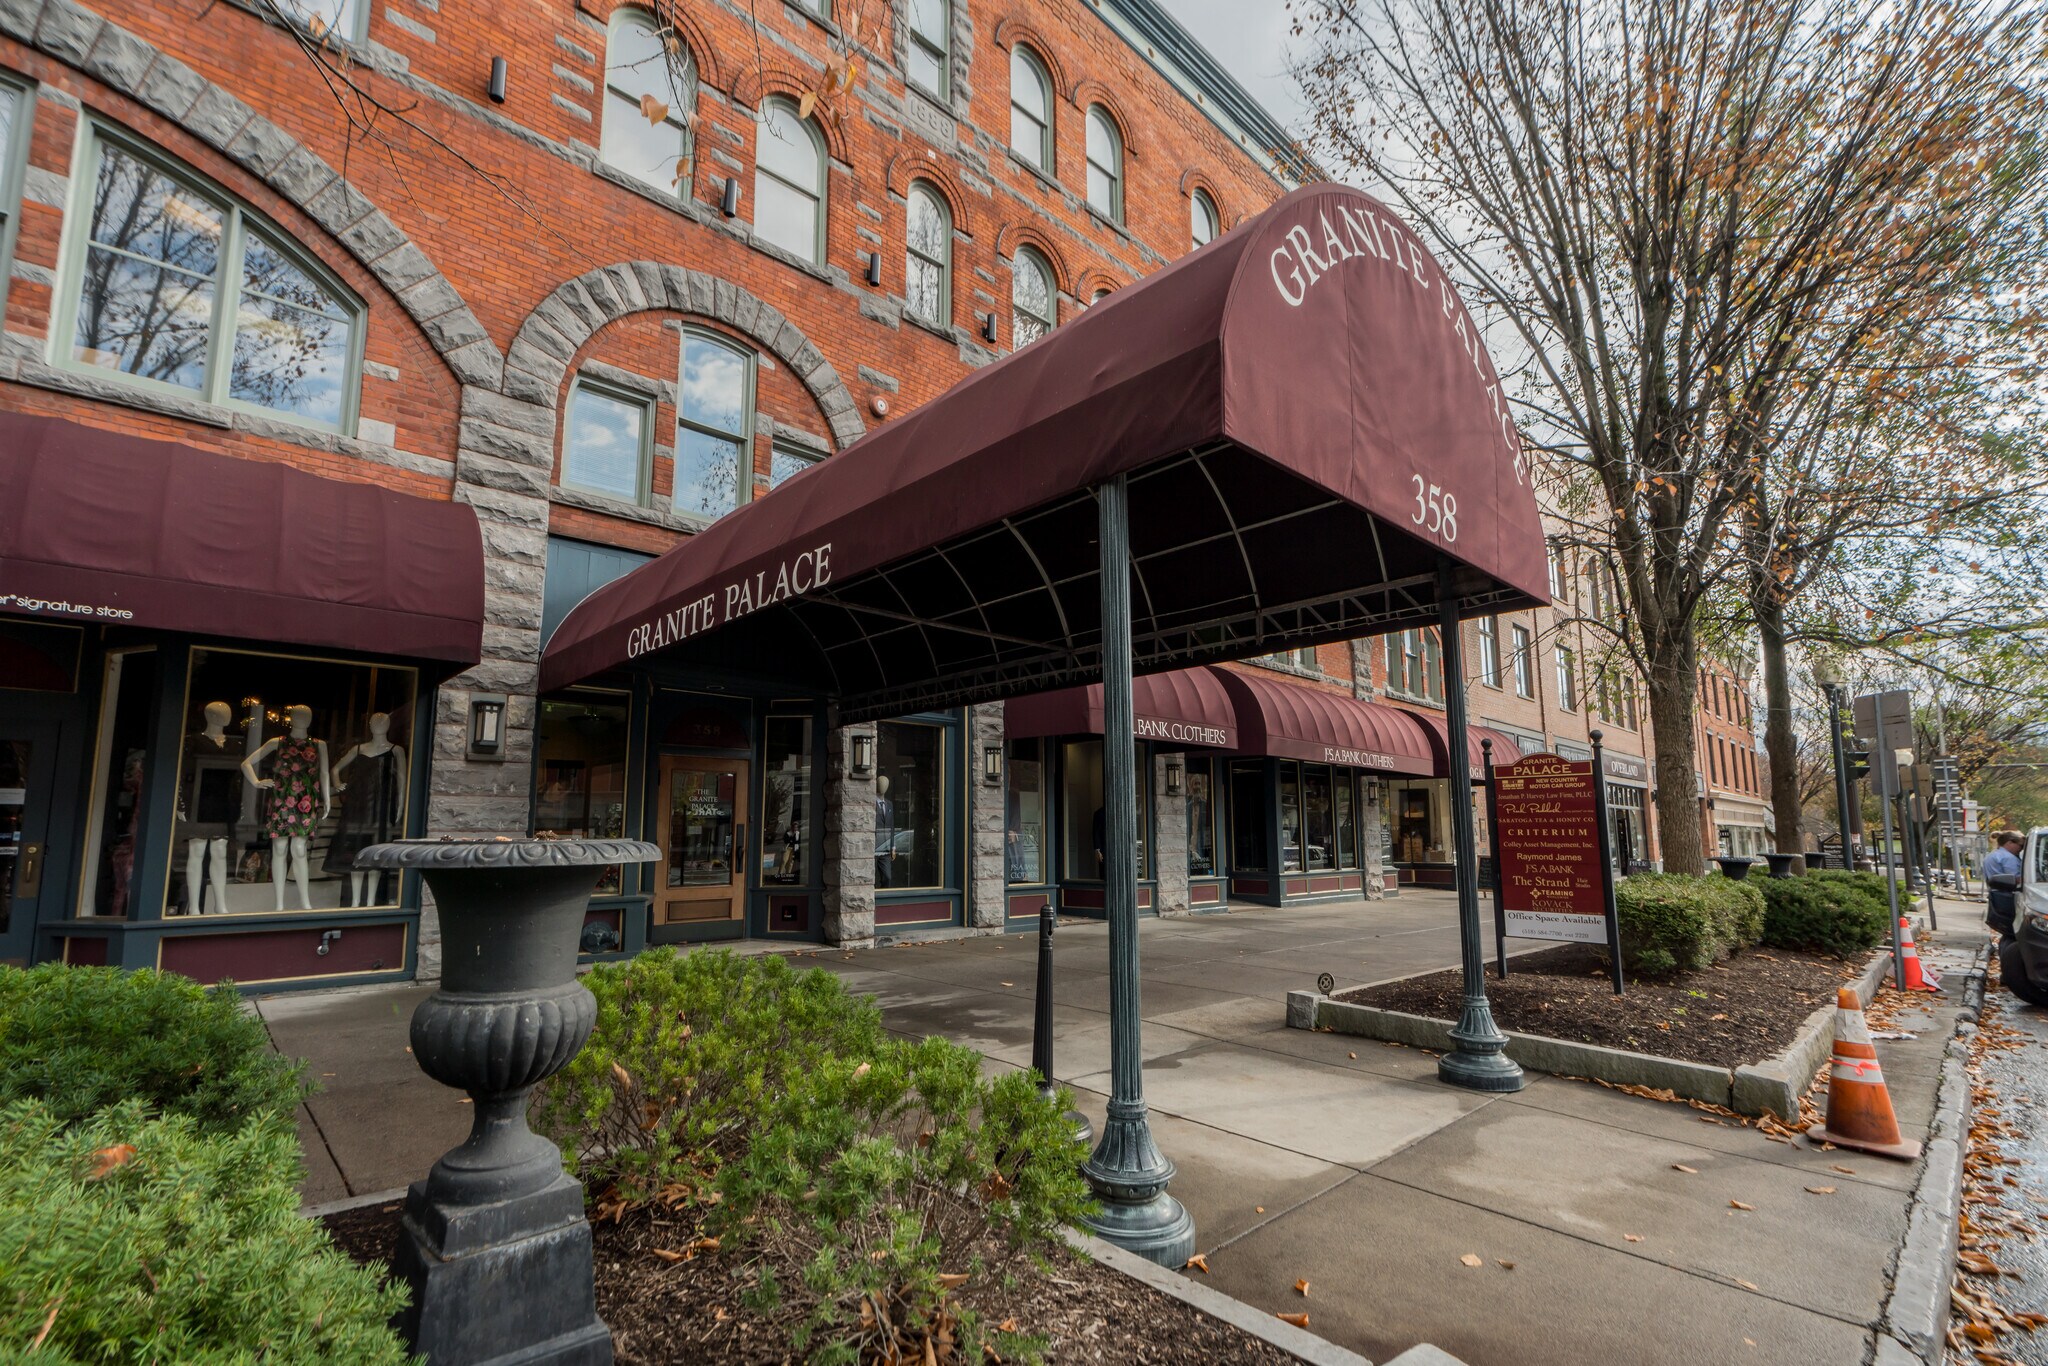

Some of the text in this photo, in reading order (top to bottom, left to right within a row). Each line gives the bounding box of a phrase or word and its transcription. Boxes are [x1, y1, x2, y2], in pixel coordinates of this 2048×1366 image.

[1270, 205, 1523, 486] GRANITE PALACE
[1412, 474, 1457, 542] 358
[16, 596, 93, 615] signature
[96, 606, 134, 619] store
[628, 543, 832, 659] GRANITE PALACE
[1137, 719, 1226, 745] BANK CLOTHIERS
[1361, 752, 1394, 768] CLOTHIERS
[1513, 764, 1572, 776] PALACE
[1611, 761, 1638, 777] OVERLAND
[688, 795, 719, 803] GRANITE
[1507, 828, 1588, 836] CRITERIUM
[1540, 841, 1581, 849] Management,
[1516, 852, 1582, 861] Raymond James
[1512, 875, 1570, 888] The Strand
[1541, 889, 1574, 897] TEAMING
[1531, 899, 1573, 909] KOVACK
[1508, 911, 1602, 925] Office Space Available
